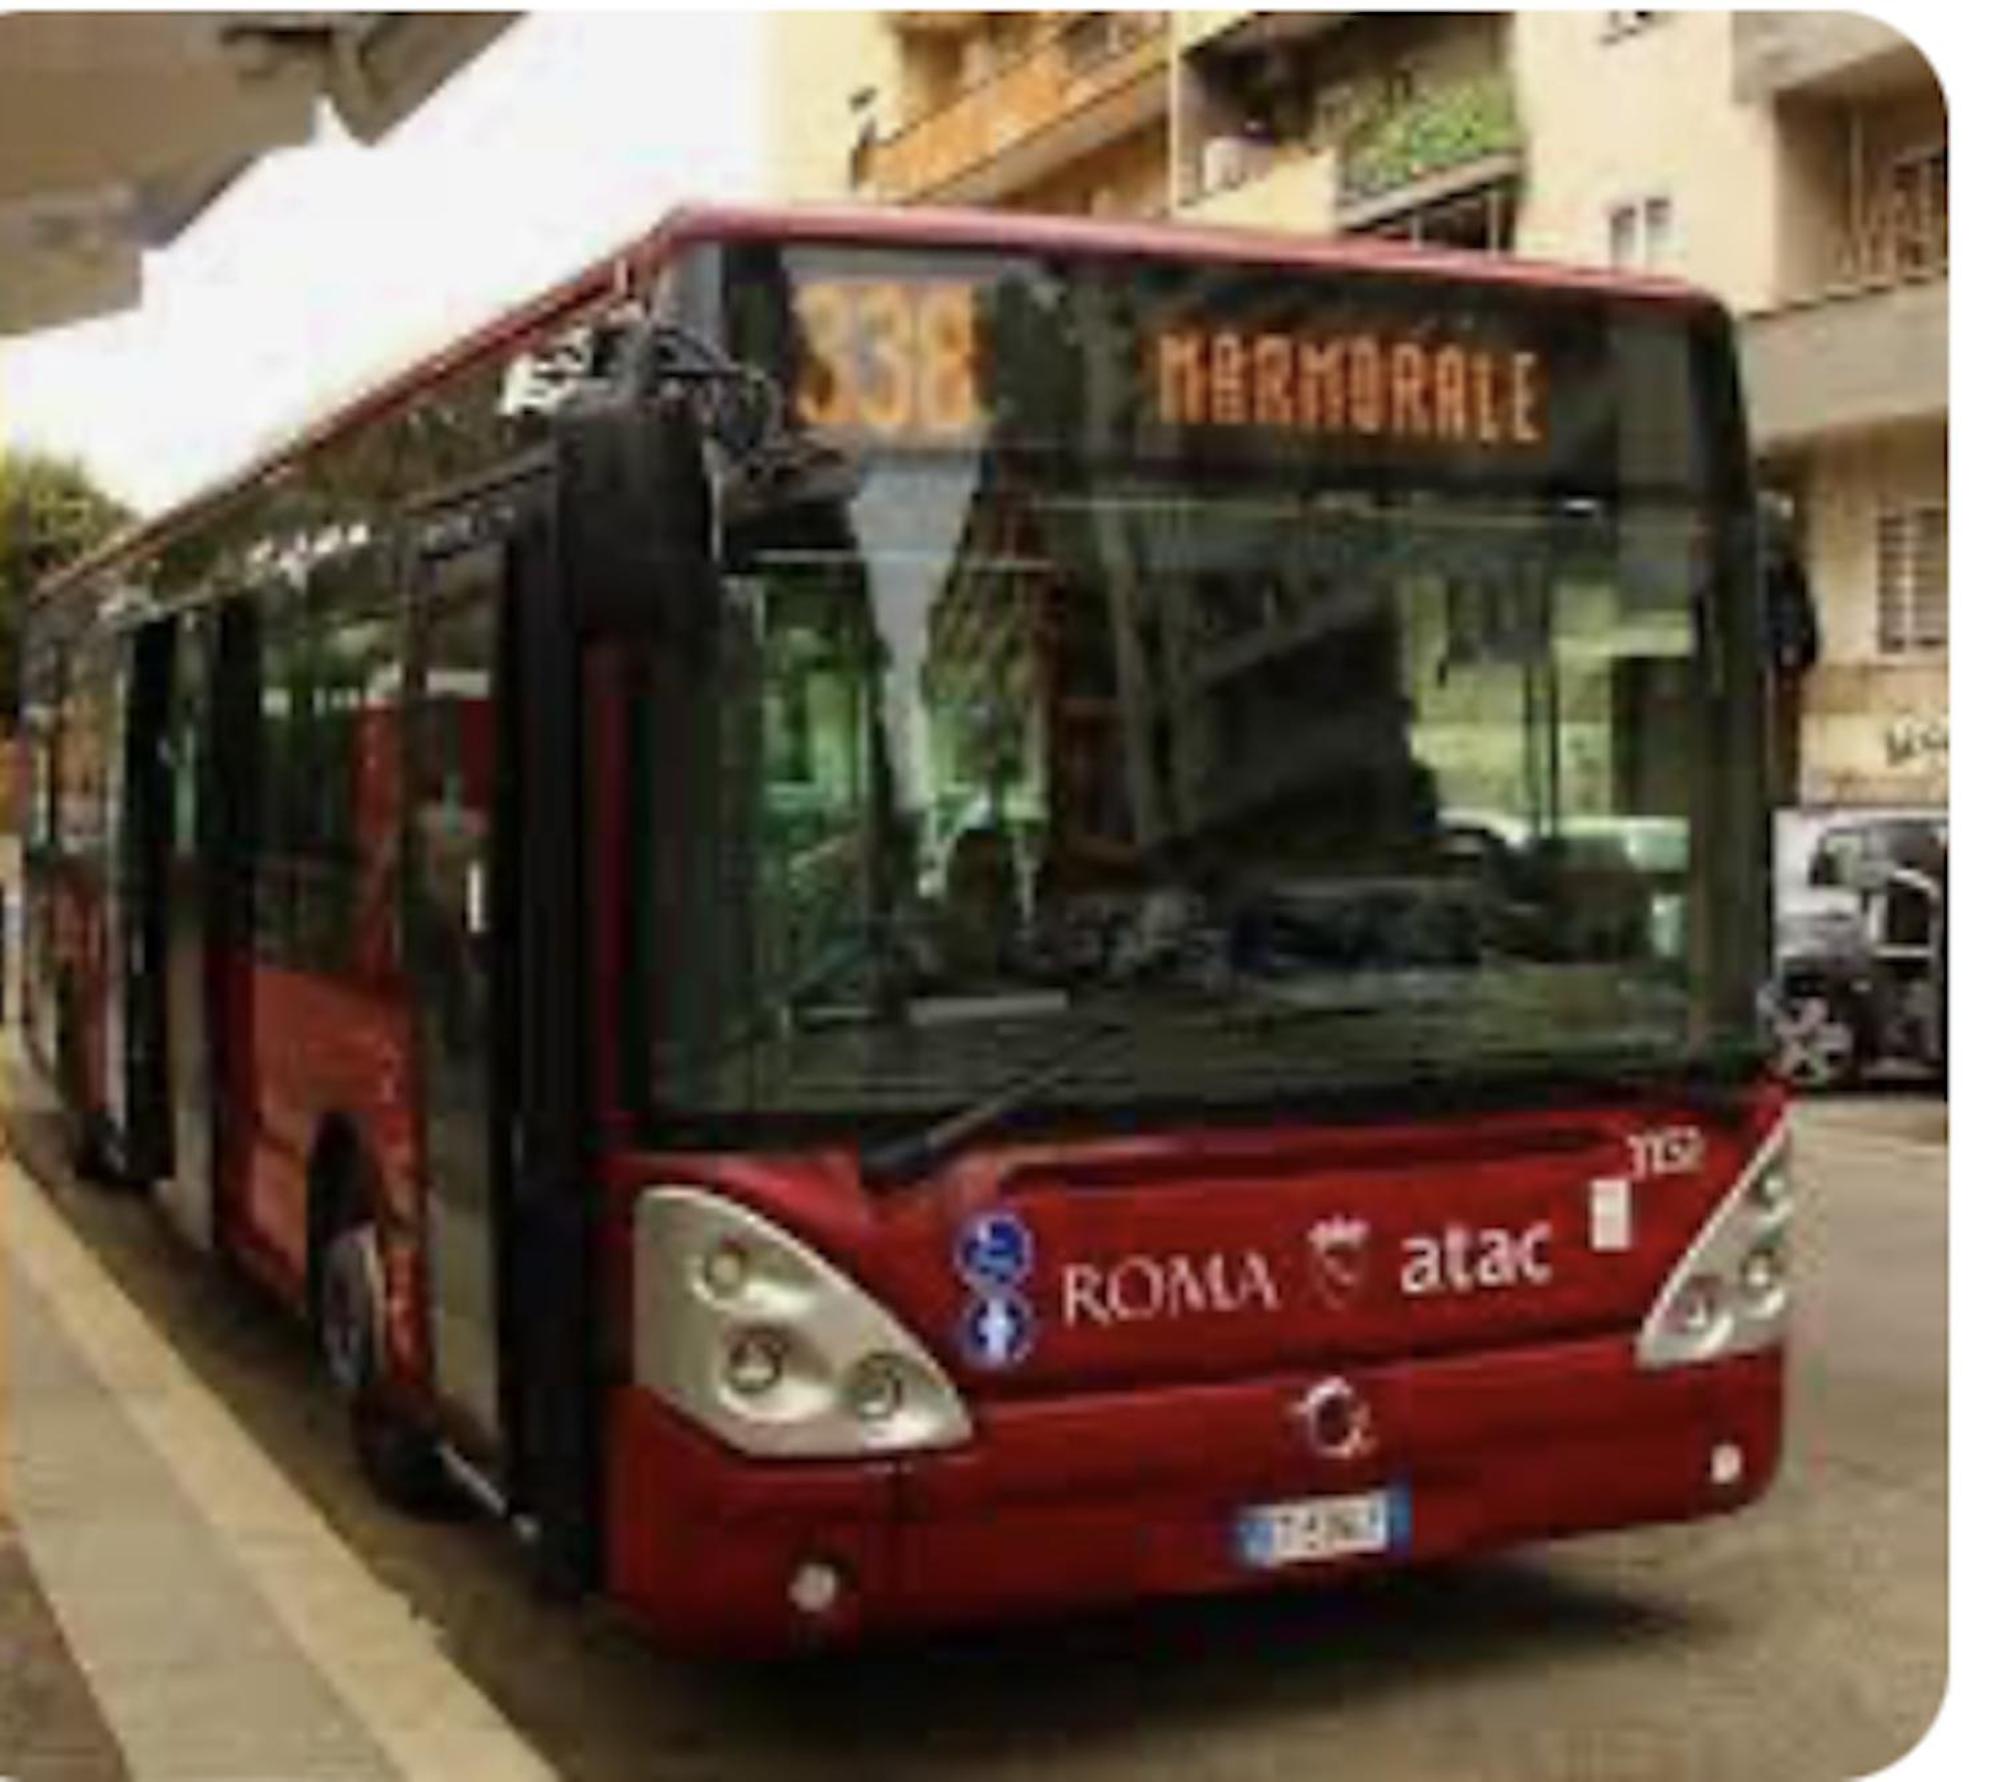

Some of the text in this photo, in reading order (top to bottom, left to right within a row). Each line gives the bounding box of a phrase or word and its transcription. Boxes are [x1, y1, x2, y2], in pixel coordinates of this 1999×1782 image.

[795, 281, 980, 427] 338
[1157, 332, 1540, 443] MARMORALE
[1062, 1221, 1552, 1327] ROMA atac
